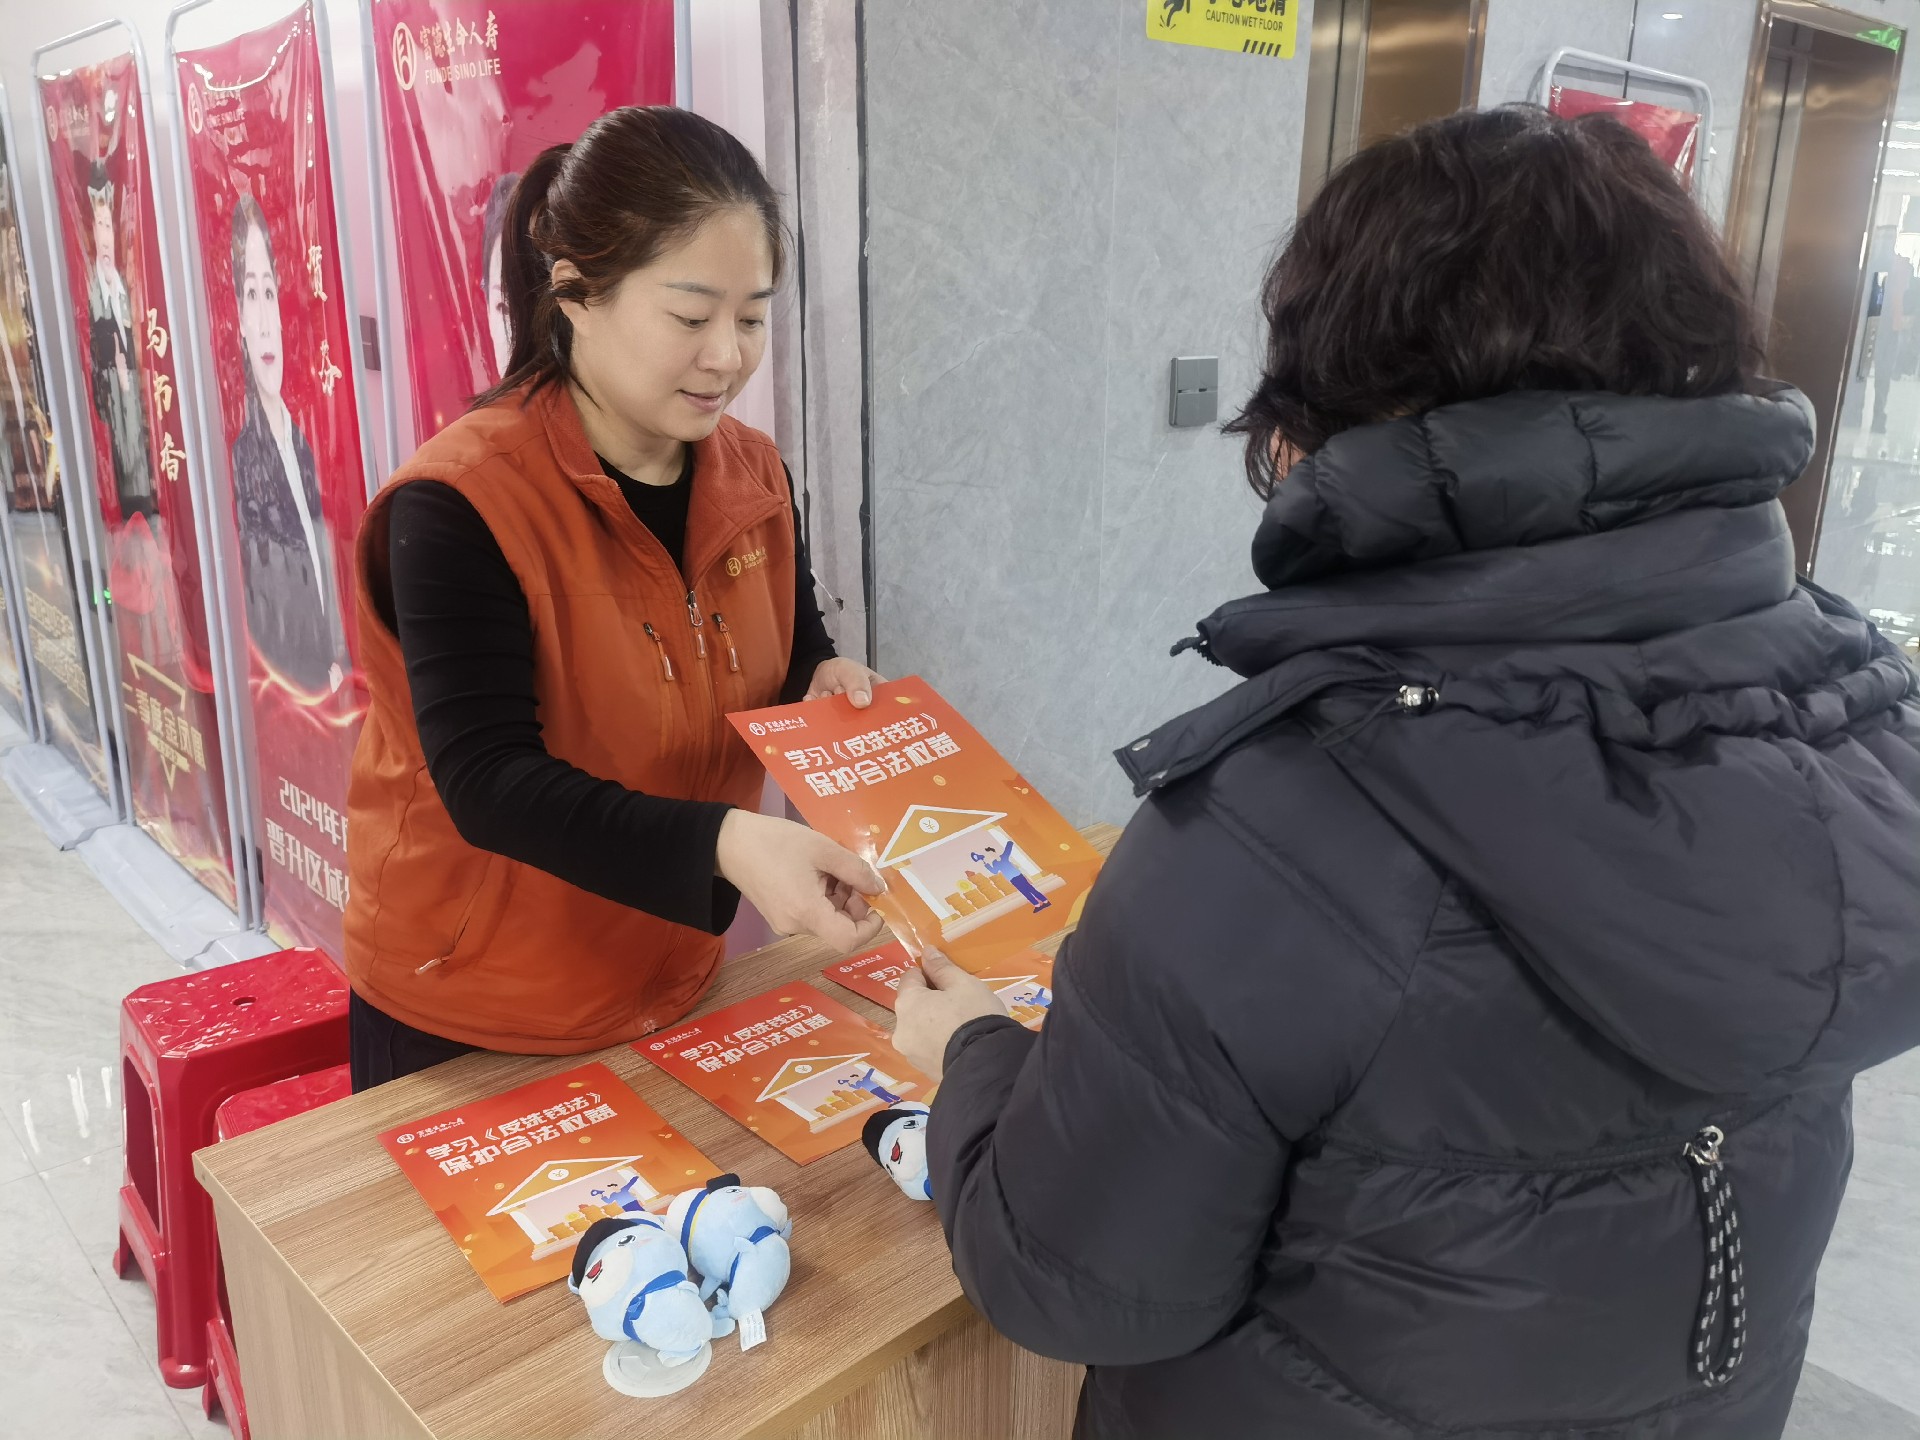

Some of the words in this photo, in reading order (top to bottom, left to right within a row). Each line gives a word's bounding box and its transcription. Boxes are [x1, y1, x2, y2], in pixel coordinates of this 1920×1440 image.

[419, 9, 499, 60] 富德生命人寿
[1206, 9, 1241, 26] CAUTION
[1241, 14, 1259, 29] WET
[1259, 18, 1284, 32] FLOOR
[425, 66, 452, 85] FUNDE
[454, 62, 477, 81] SINO
[478, 58, 502, 77] LIFE
[784, 712, 938, 771] 学习《反洗钱法》
[804, 731, 962, 798] 保护合法权益
[679, 1004, 814, 1062] 学习《反洗钱法》
[696, 1013, 834, 1074] 保护合法权益
[425, 1092, 602, 1161] 学习《反洗钱法》
[438, 1103, 618, 1177] 保护合法权益
